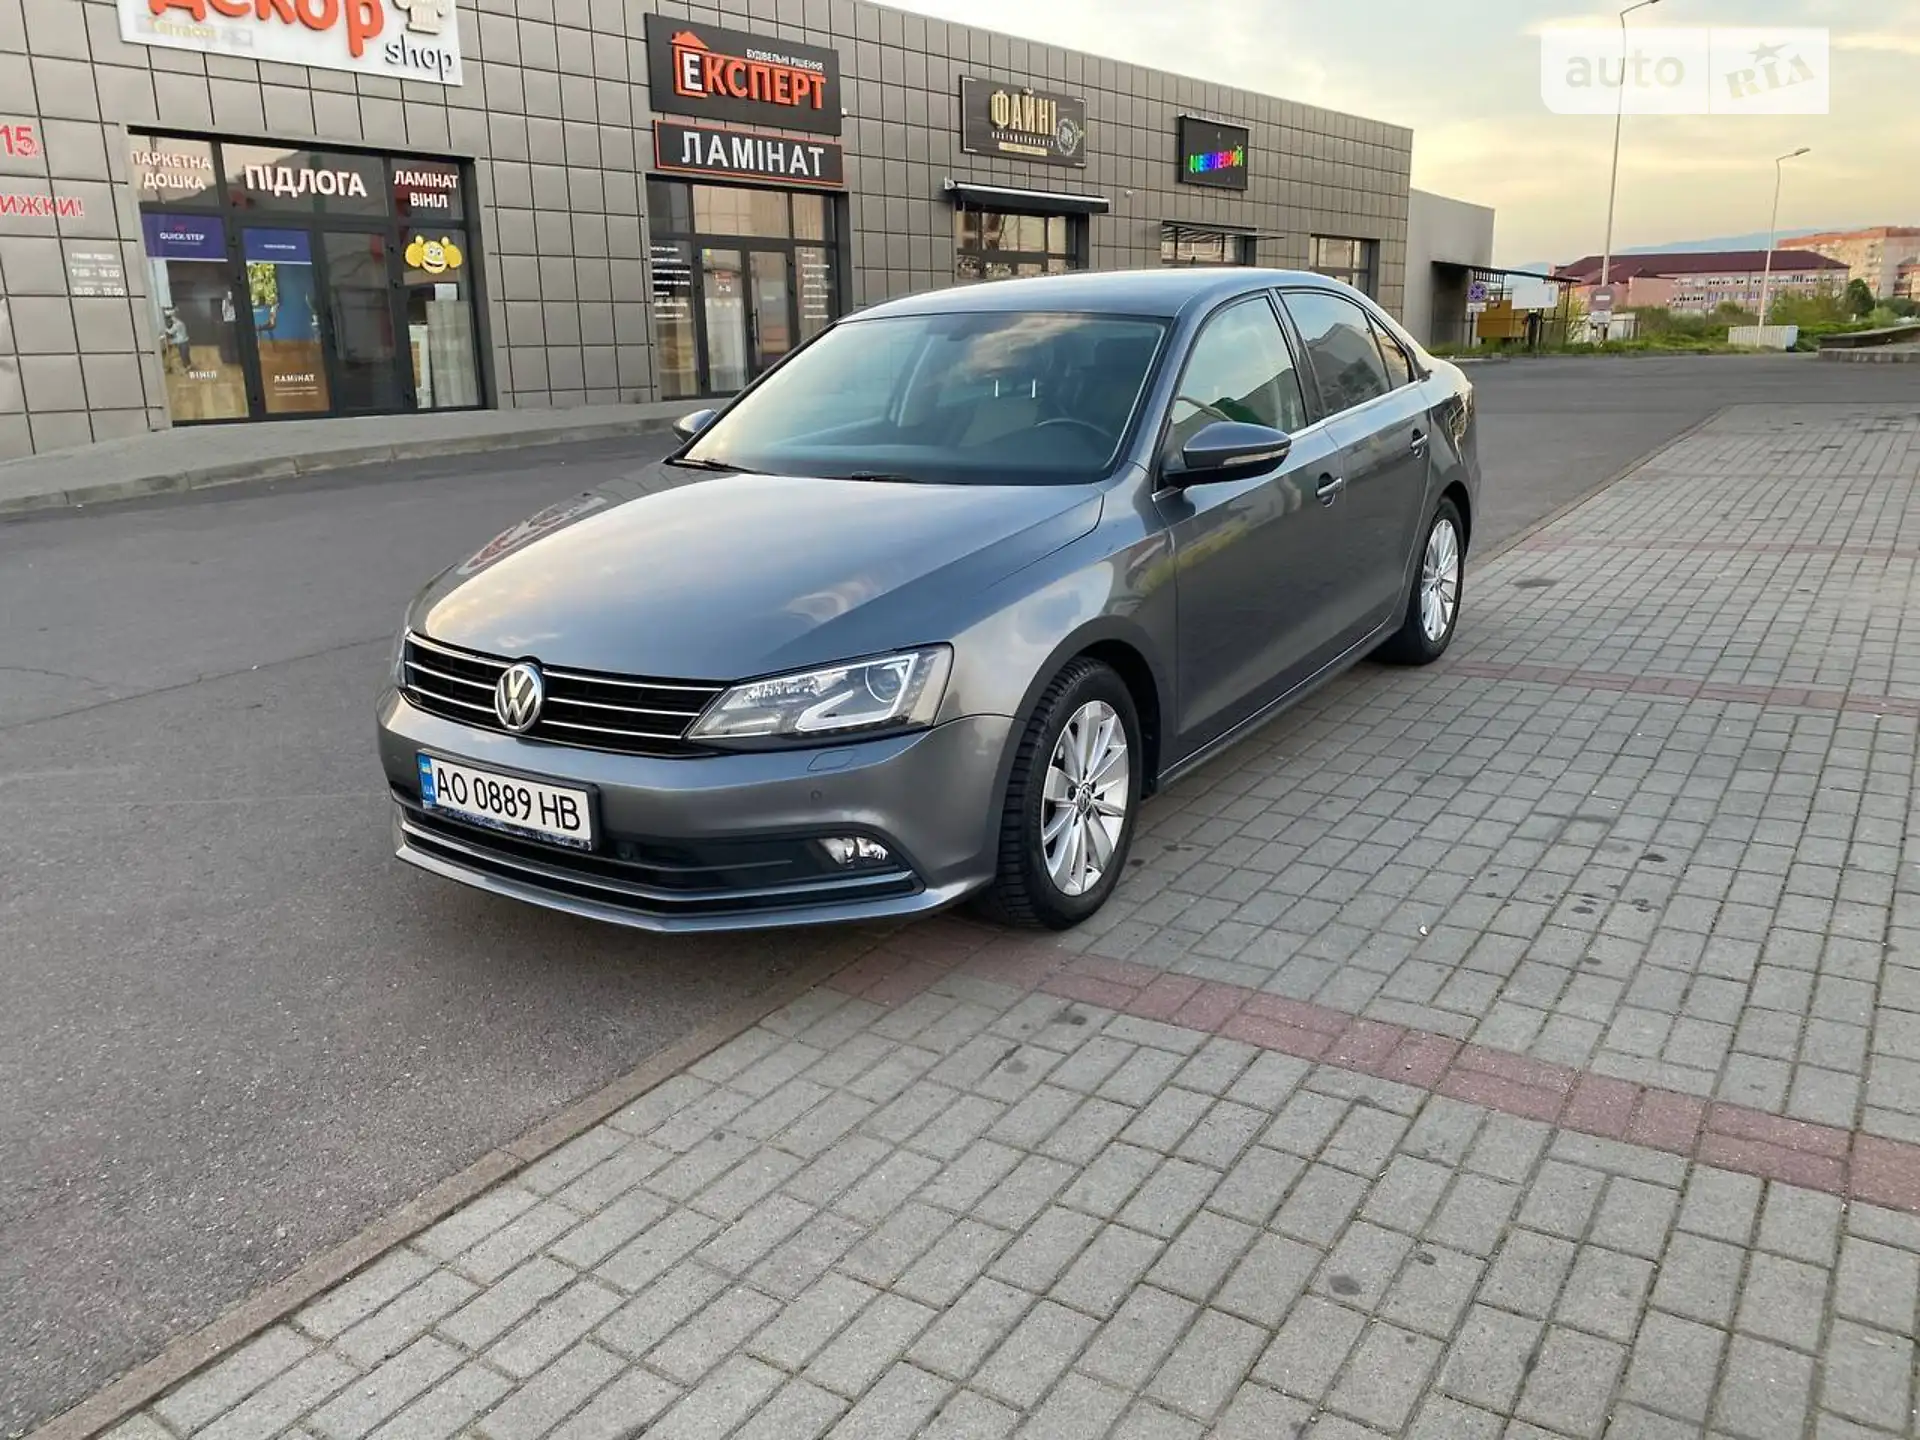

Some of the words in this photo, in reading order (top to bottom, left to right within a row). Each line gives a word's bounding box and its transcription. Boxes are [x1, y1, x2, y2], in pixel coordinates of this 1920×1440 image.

[385, 34, 452, 81] shop
[682, 52, 826, 109] ЕКСПЕРТ
[991, 88, 1057, 136] ФАЙНІ
[132, 150, 212, 171] ПАРКЕТНА
[682, 131, 825, 177] ЛАМІНАТ
[143, 172, 206, 191] ДОШКА
[245, 164, 367, 198] ПІДЛОГА
[394, 170, 459, 189] ЛАМІНАТ
[410, 192, 449, 209] ВІНІЛ
[474, 777, 532, 821] 0889
[538, 791, 581, 831] HB
